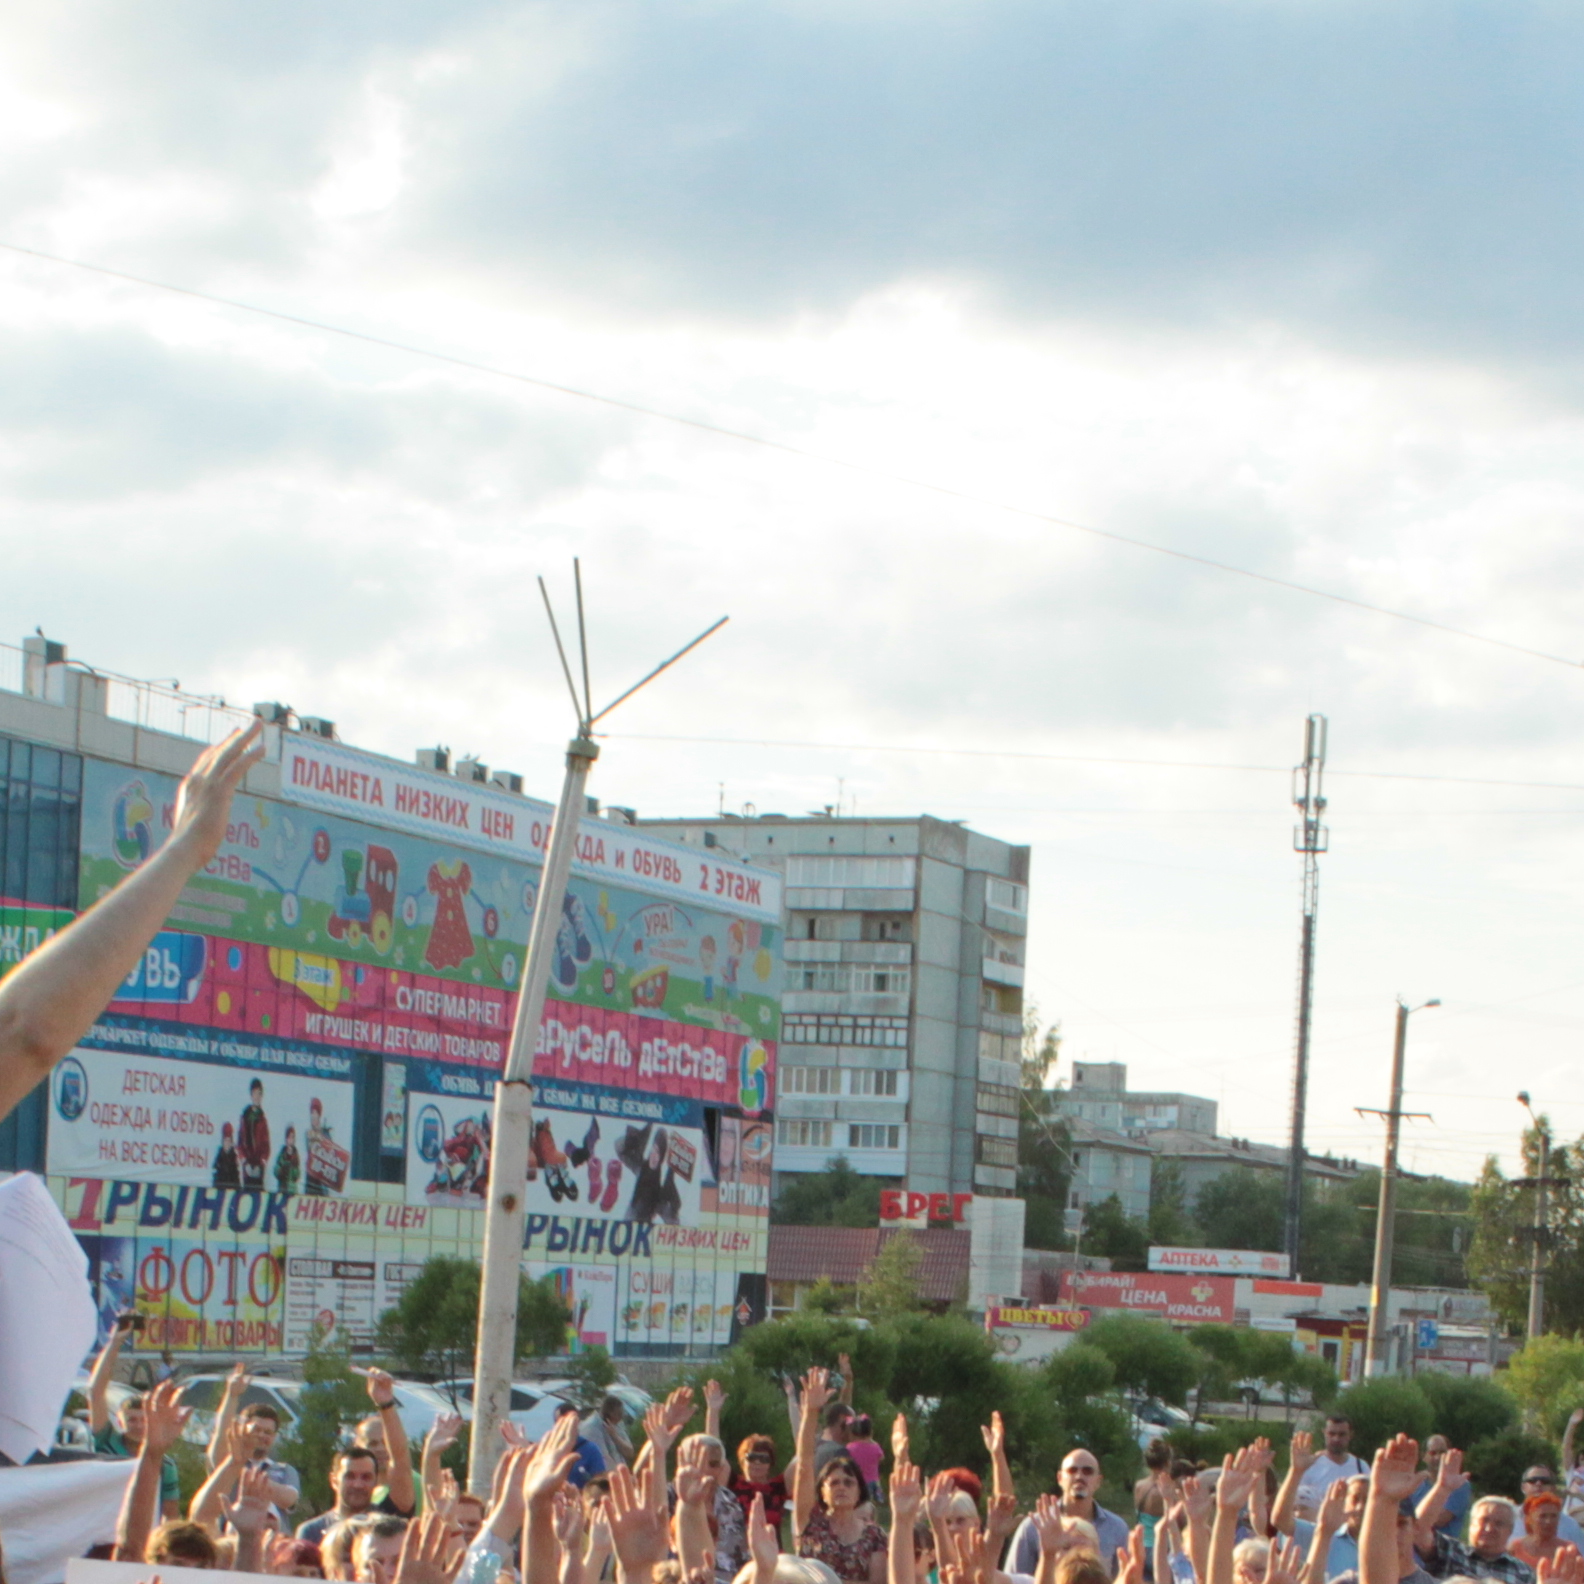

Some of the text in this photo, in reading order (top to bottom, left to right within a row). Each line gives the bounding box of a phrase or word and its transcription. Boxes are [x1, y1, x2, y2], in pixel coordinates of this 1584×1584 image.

[292, 755, 385, 807] ПЛАНЕТА
[395, 782, 470, 829] НИЗКИХ
[481, 806, 515, 840] ЦЕН
[633, 848, 682, 884] ОБУВЬ
[699, 864, 709, 891] 2
[125, 946, 181, 989] УВЬ
[396, 985, 501, 1026] СУПЕРМАРКЕТ
[305, 1012, 501, 1062] ИГРУШЕК И ДЕТСКИХ ТОВАРОВ
[122, 1068, 186, 1096] ДЕТСКАЯ
[89, 1102, 215, 1135] ОДЕЖДА И ОБУВЬ
[98, 1139, 210, 1169] НА ВСЕ СЕЗОНЫ
[104, 1181, 296, 1235] РЫНОК
[295, 1198, 380, 1226] НИЗКИХ
[384, 1205, 427, 1231] ЦЕН
[879, 1190, 974, 1223] БРЕГ
[522, 1213, 751, 1258] РЫНОК НИЗКИХ ЦЕН
[1159, 1251, 1220, 1268] АПТЕКА
[138, 1246, 282, 1308] ФОТО
[631, 1271, 674, 1295] СУШИ
[1120, 1288, 1168, 1307] ЦЕНА
[1167, 1302, 1223, 1318] КРАСНА
[216, 1319, 283, 1347] ТОВАРЫ
[999, 1307, 1064, 1326] ЦВЕТЫ
